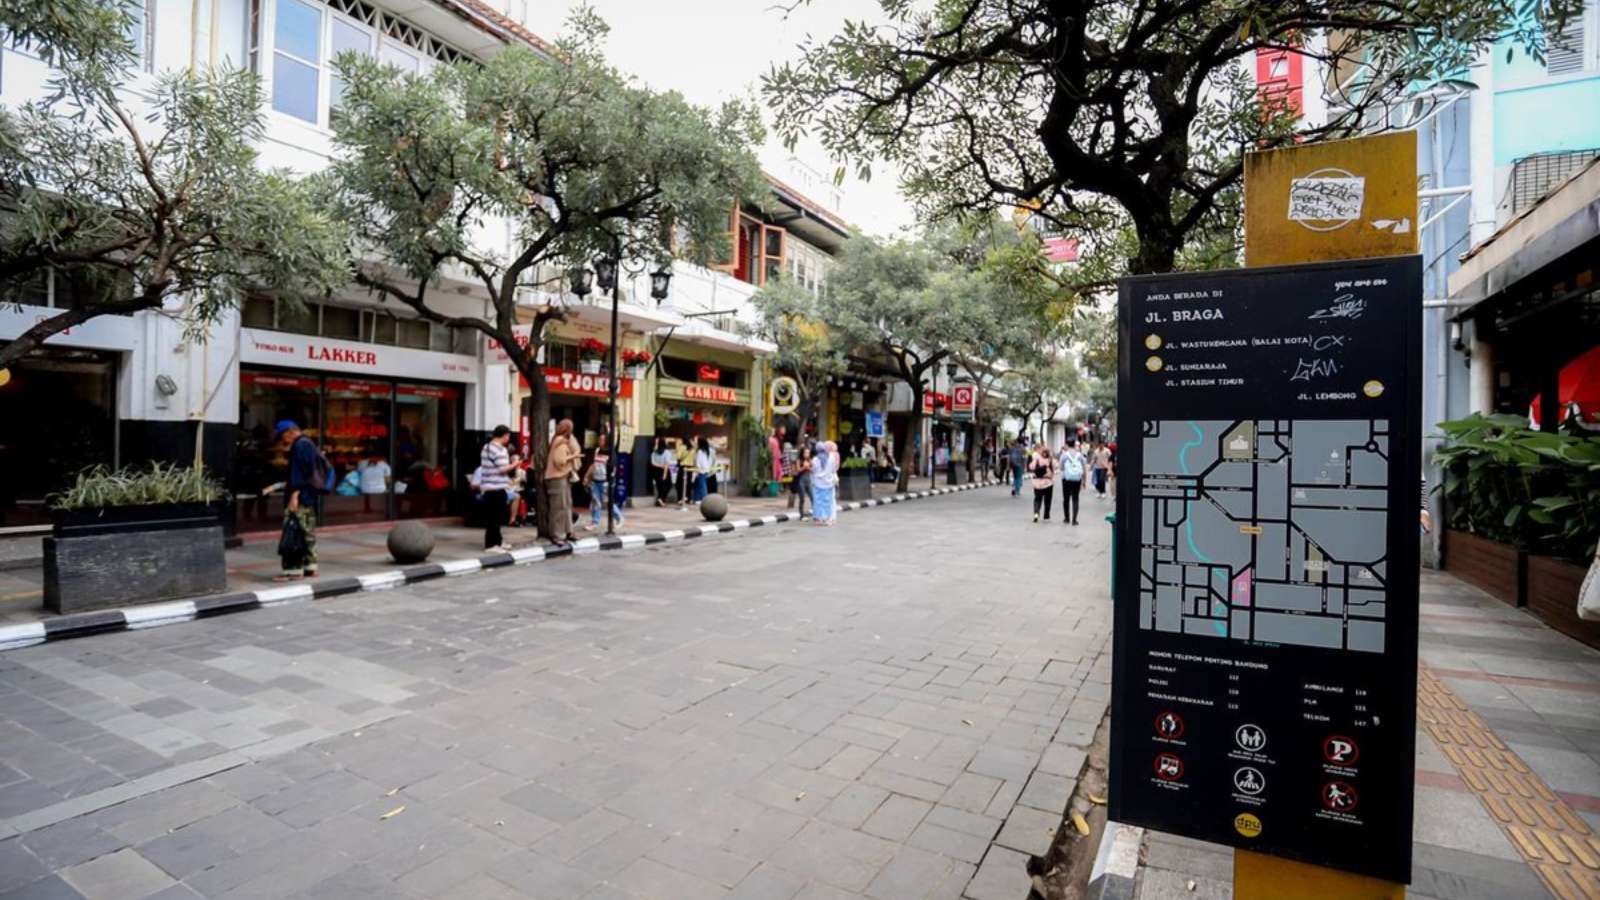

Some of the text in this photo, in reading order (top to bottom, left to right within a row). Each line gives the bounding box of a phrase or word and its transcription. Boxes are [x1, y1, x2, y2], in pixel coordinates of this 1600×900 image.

[1174, 291, 1208, 300] BERADA
[1145, 308, 1224, 323] JL. BRAGA
[1252, 336, 1281, 346] (BALAI
[1284, 334, 1313, 346] KOTA)
[308, 346, 376, 365] LAKKER
[1174, 653, 1202, 662] TELEPON
[1204, 656, 1233, 666] PENTING
[1234, 660, 1268, 670] BANDUNG
